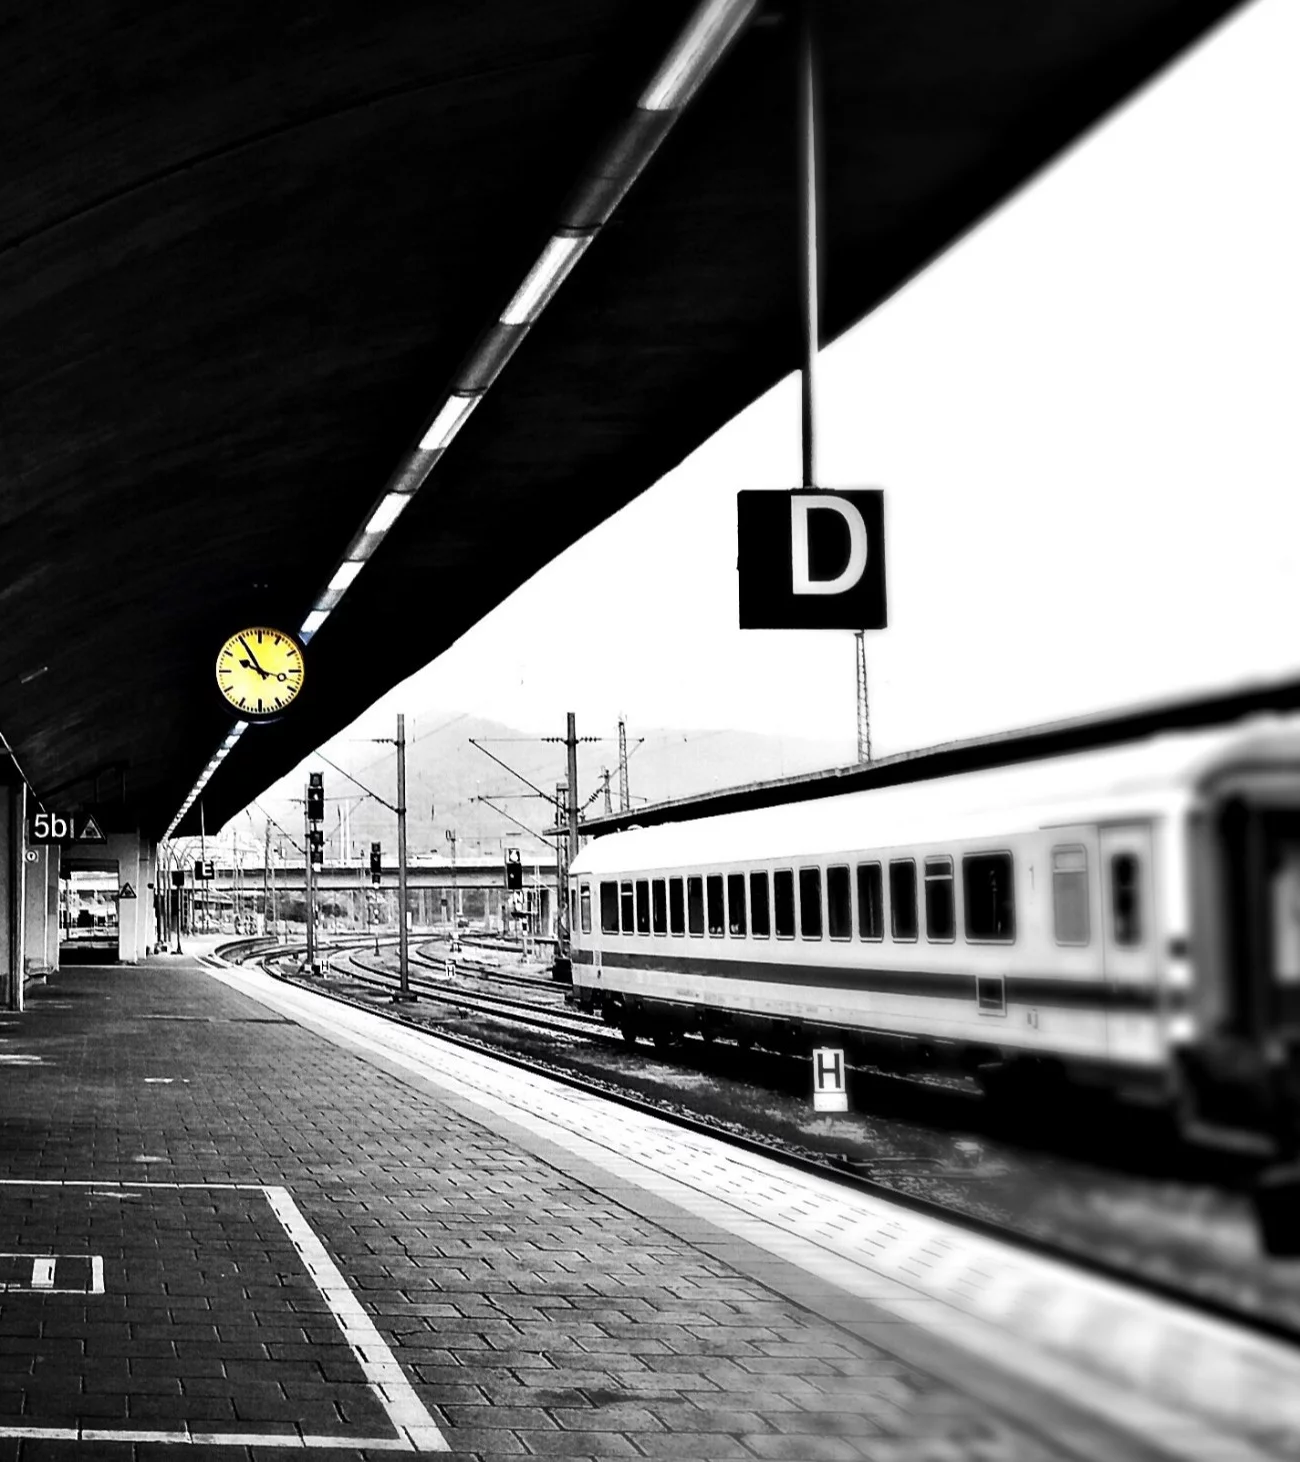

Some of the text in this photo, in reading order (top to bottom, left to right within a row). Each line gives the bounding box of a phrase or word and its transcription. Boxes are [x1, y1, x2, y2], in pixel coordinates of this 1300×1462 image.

[791, 495, 868, 595] D
[34, 812, 67, 838] 5b
[202, 861, 212, 877] E
[817, 1053, 841, 1089] H
